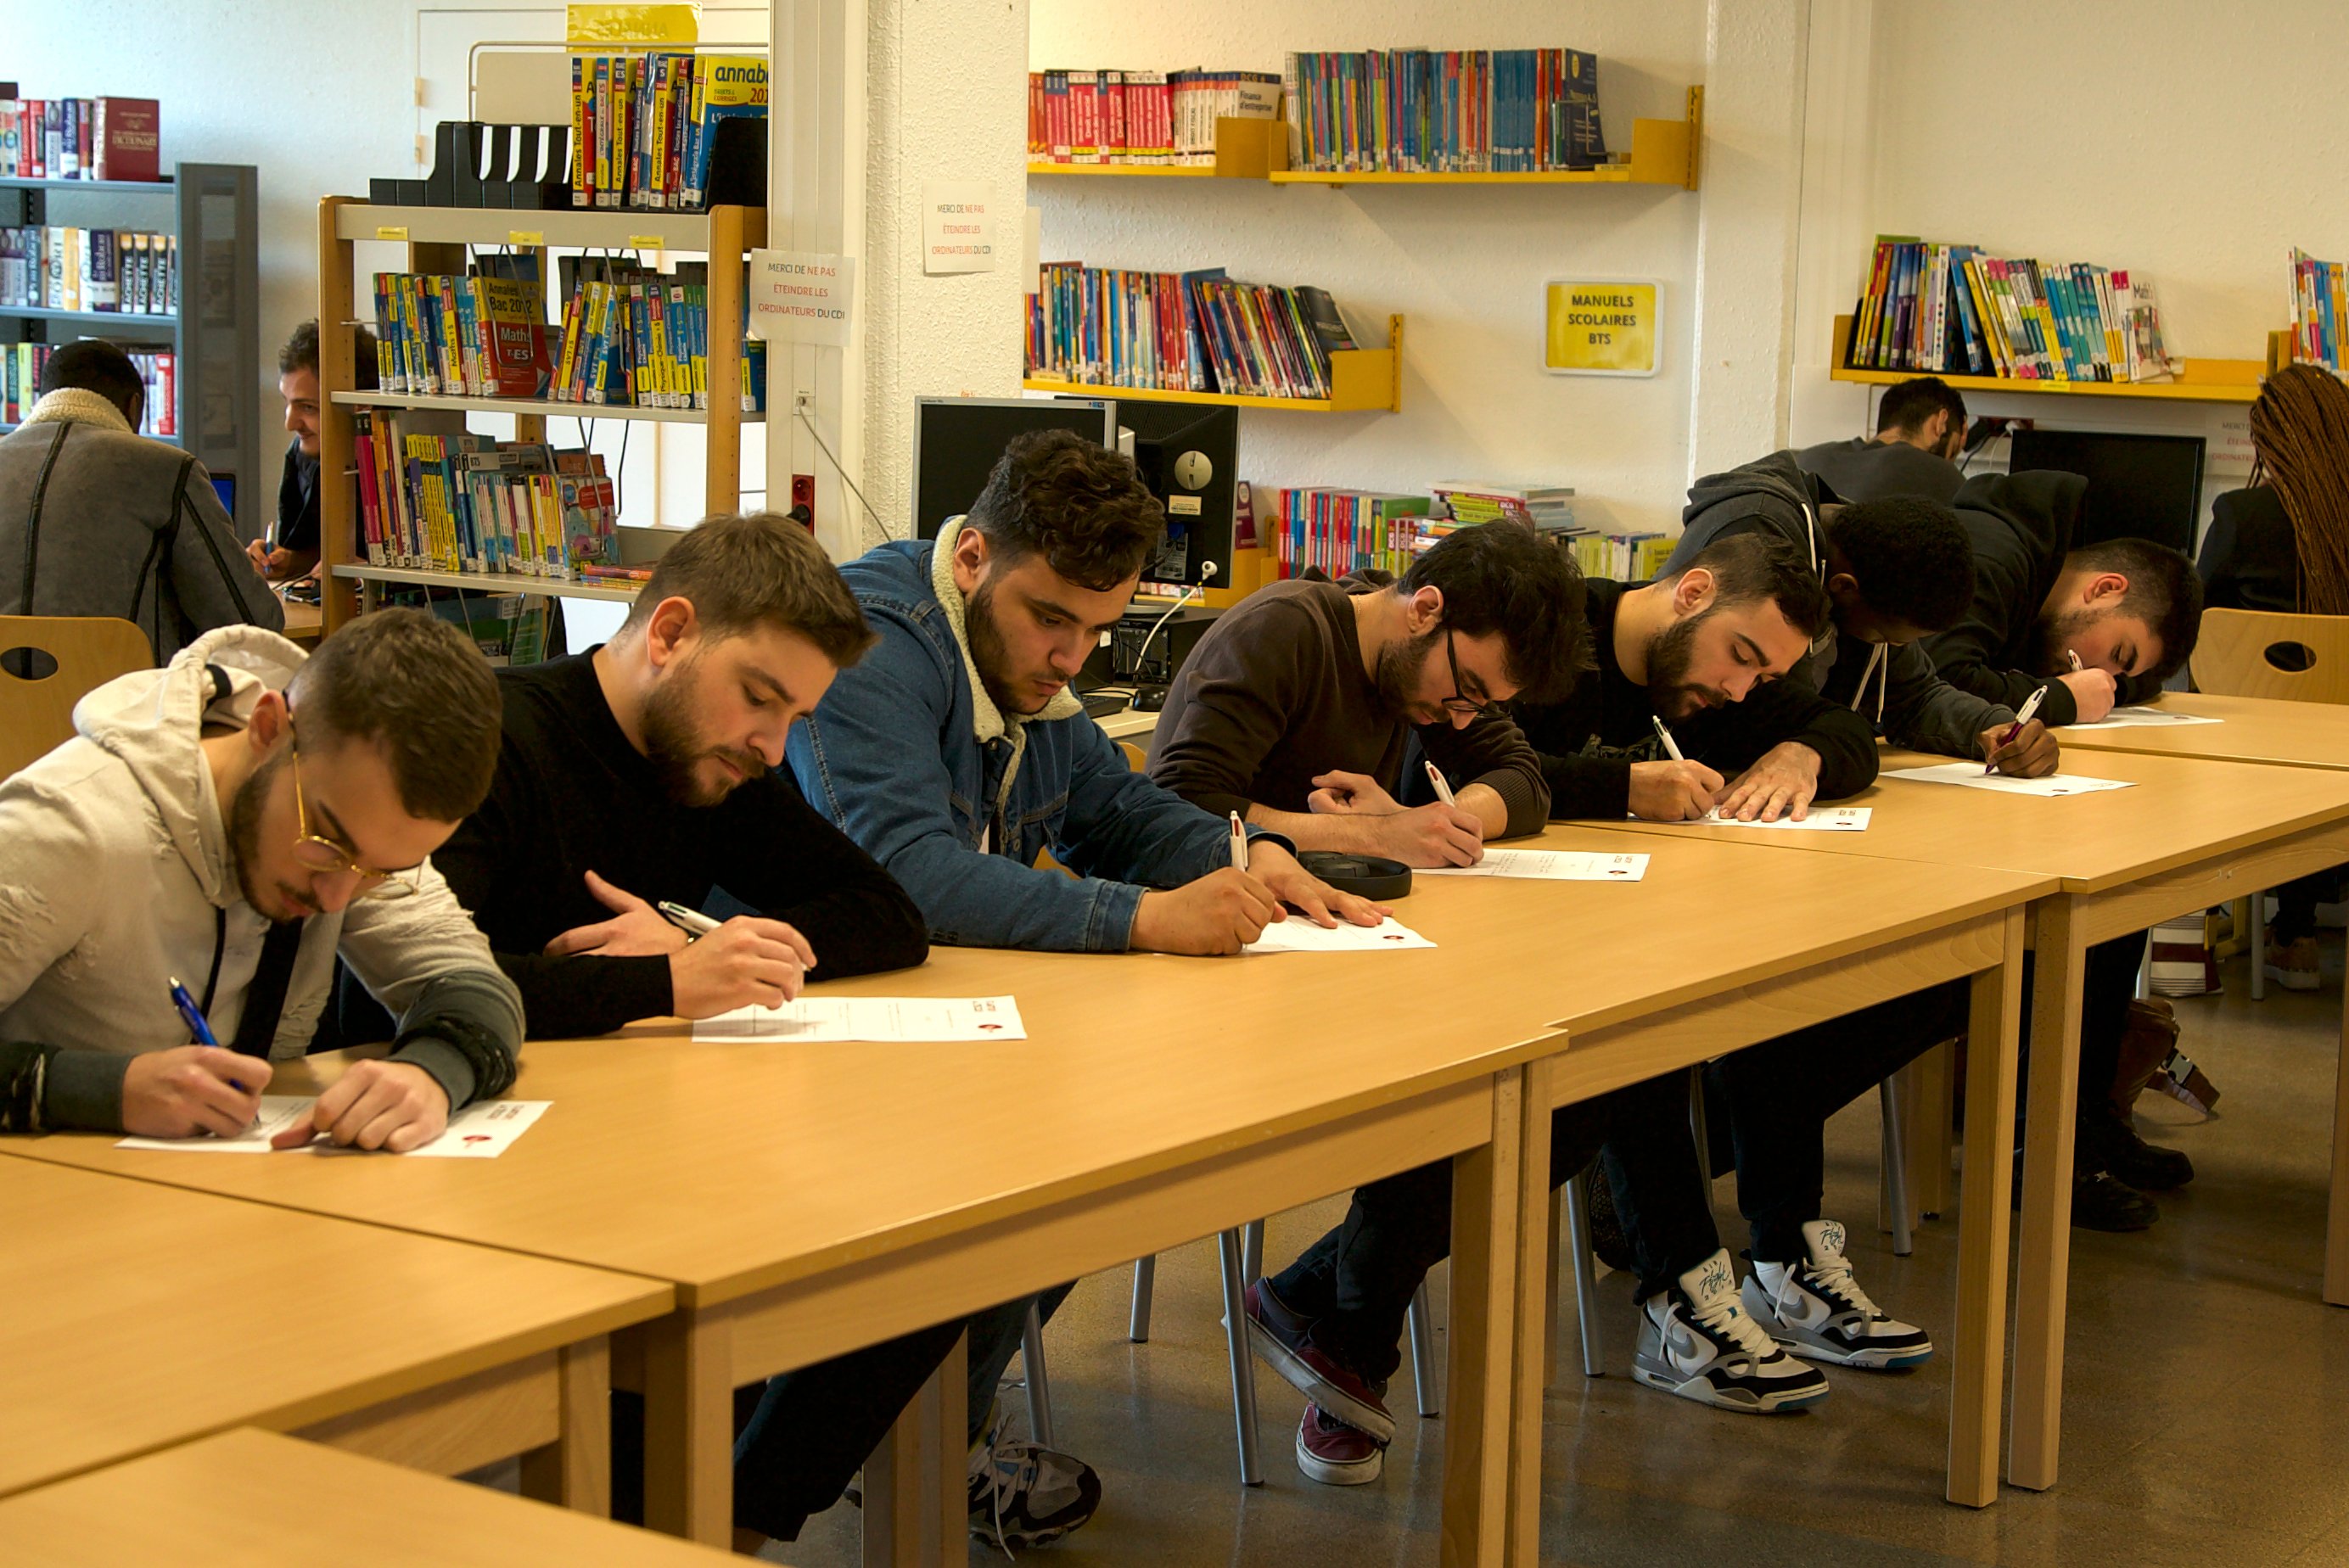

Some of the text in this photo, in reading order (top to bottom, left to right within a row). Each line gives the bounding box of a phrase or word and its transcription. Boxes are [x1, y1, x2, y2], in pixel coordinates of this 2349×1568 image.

[574, 94, 582, 187] Annales Tout-en-un
[654, 148, 663, 182] Annales
[937, 204, 956, 214] MERCI
[956, 204, 965, 214] DE
[767, 262, 836, 277] MERCI DE NE PAS
[124, 256, 133, 304] ACHETTE
[138, 256, 149, 304] ACHETTE
[156, 257, 166, 304] ACHETTE
[773, 281, 828, 298] ÉTEINDRE LES
[490, 297, 507, 311] Bac
[1572, 294, 1634, 307] MANUELS
[758, 303, 845, 320] ORDINATEURS DU CDI
[1568, 313, 1637, 326] SCOLAIRES
[1589, 333, 1612, 344] BTS
[449, 338, 457, 367] Maths
[482, 351, 491, 376] Maths
[656, 333, 666, 392] Physique-Chimie
[470, 456, 480, 468] BTS
